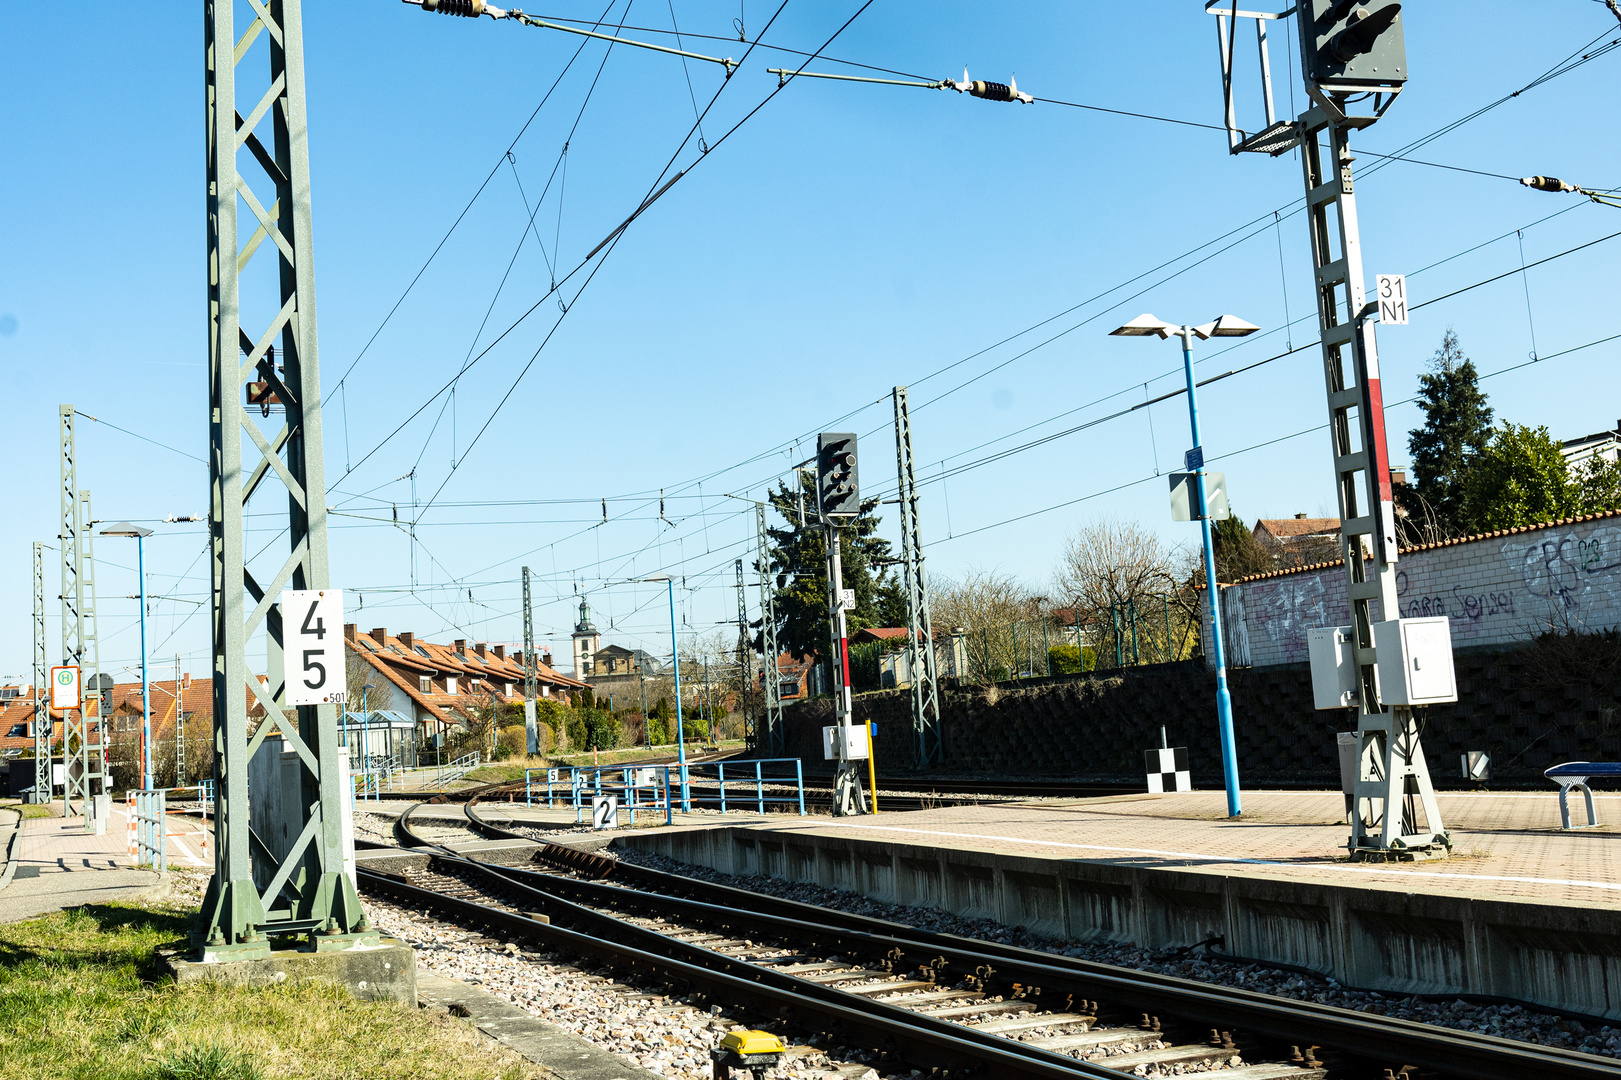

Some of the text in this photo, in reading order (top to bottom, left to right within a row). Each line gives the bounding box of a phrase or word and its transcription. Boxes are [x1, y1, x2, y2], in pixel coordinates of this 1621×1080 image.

[1380, 278, 1403, 298] 31
[1381, 301, 1405, 321] N1
[843, 590, 854, 600] 31
[843, 600, 855, 608] N2
[300, 600, 326, 640] 4
[61, 674, 70, 682] H
[303, 649, 326, 690] 5
[550, 770, 556, 781] 5
[600, 800, 611, 825] 2
